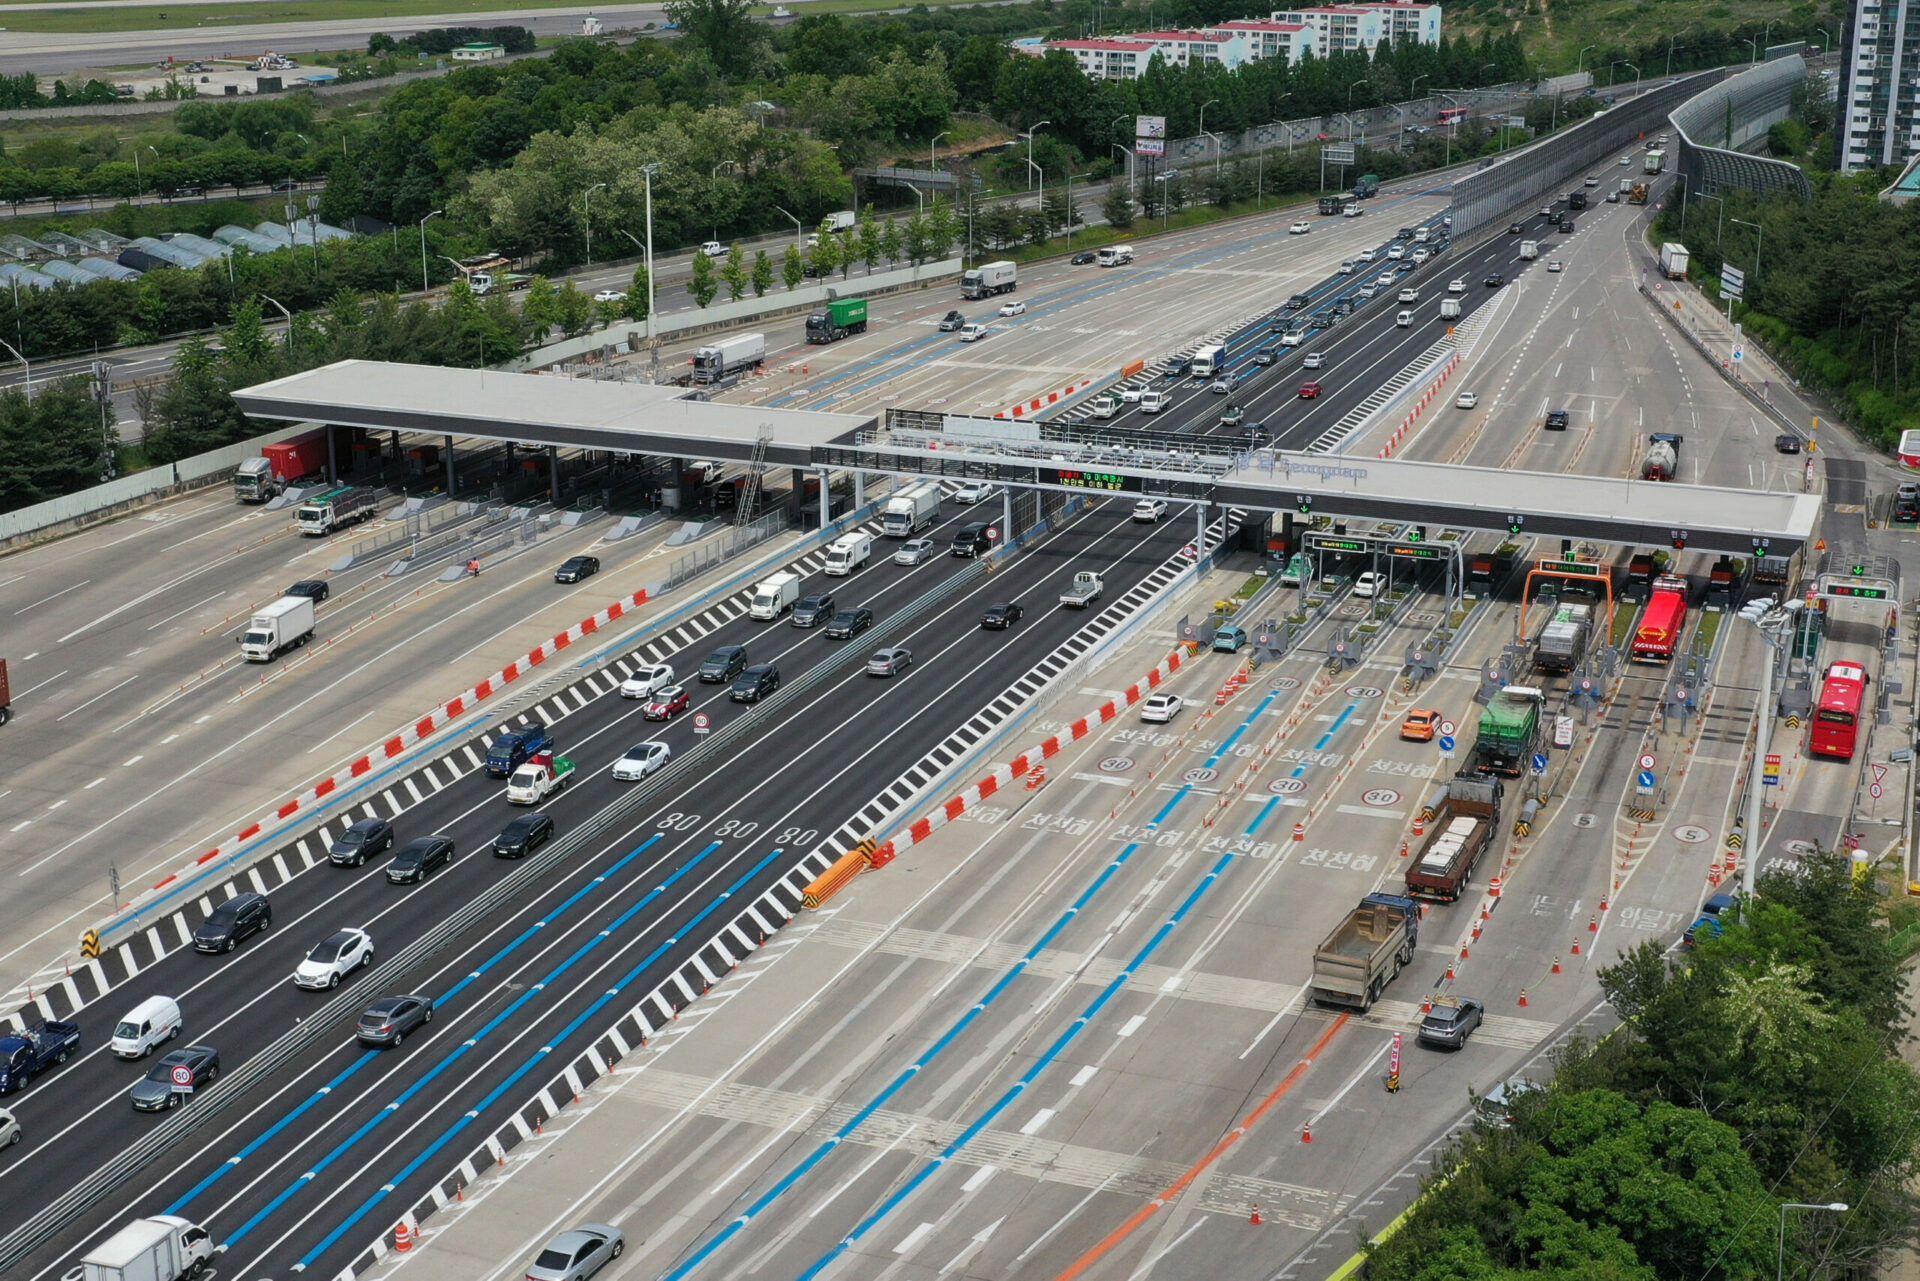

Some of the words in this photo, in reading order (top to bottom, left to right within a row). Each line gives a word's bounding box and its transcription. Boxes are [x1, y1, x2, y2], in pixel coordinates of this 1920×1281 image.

[1280, 458, 1368, 480] Seongnam
[1354, 687, 1378, 697] 30
[1102, 759, 1127, 769] 30
[1644, 757, 1651, 766] 5
[1187, 770, 1212, 781] 30
[1271, 781, 1301, 791] 30
[1367, 792, 1393, 802] 30
[656, 812, 702, 831] 80
[1020, 812, 1095, 837] 천천히
[1579, 816, 1592, 826] 5
[714, 819, 759, 839] 80
[774, 827, 819, 847] 80
[1106, 824, 1188, 848] 천천히
[1685, 830, 1699, 840] 5
[1201, 834, 1279, 860] 천천히
[1298, 848, 1379, 873] 천천히
[175, 1071, 188, 1081] 80
